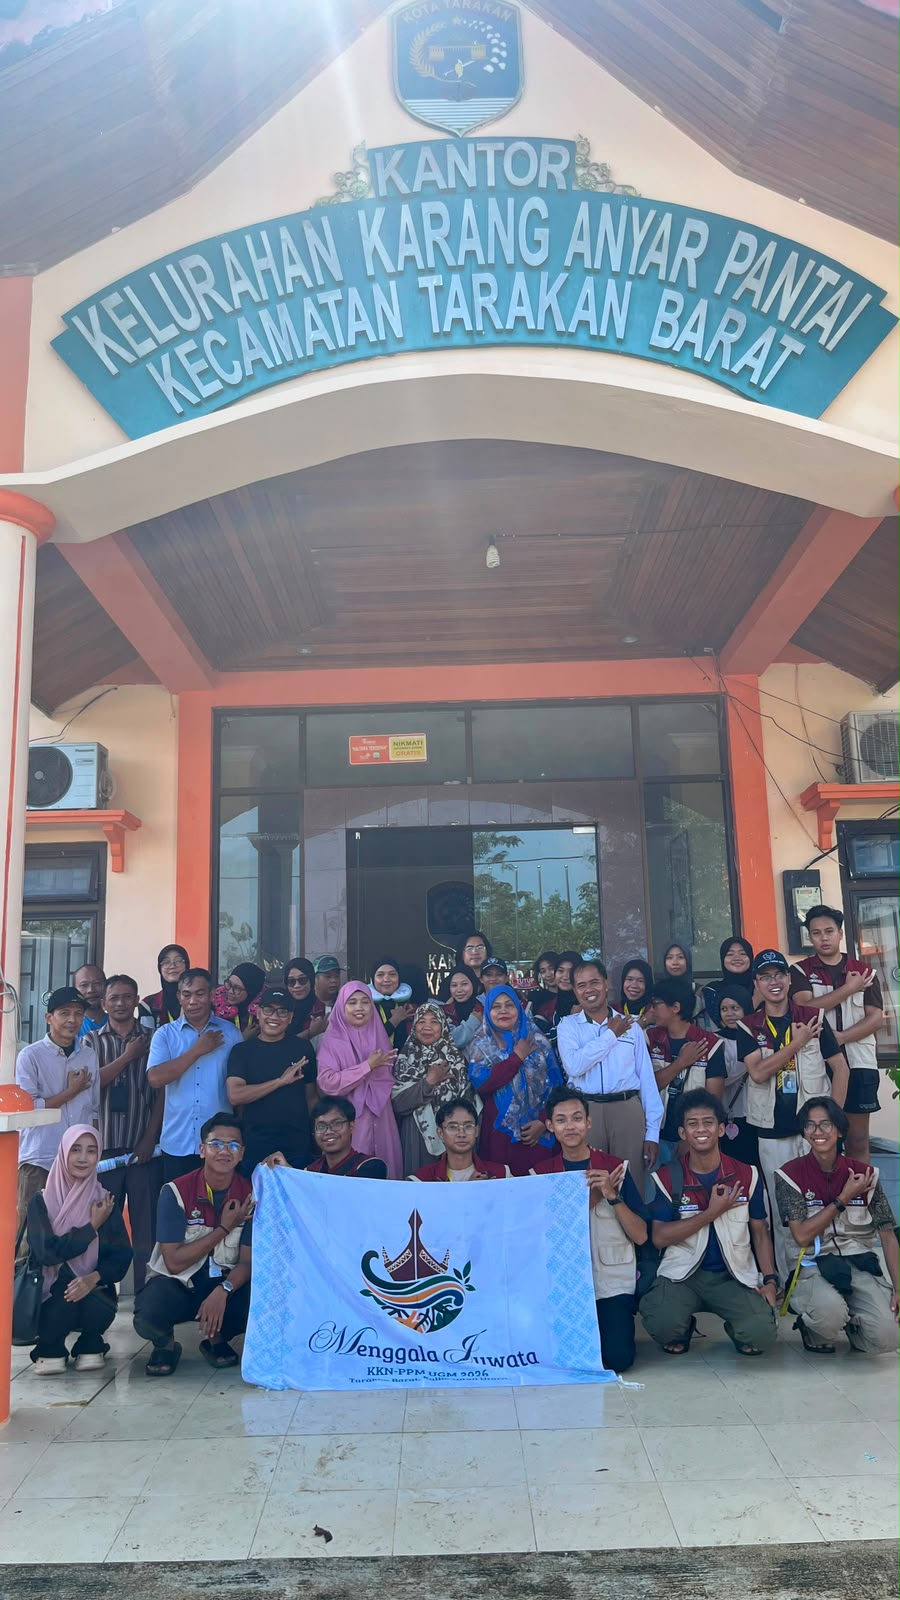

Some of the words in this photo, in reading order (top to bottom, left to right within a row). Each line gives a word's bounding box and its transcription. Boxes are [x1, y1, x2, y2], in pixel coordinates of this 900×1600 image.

[402, 3, 441, 23] KOTA
[445, 0, 513, 21] TARAKAN
[374, 141, 571, 197] KANTOR
[71, 215, 345, 377] KELURAHAN
[358, 196, 550, 277] KARANG
[563, 200, 709, 290] ANYAR
[713, 229, 873, 352] PANTAI
[146, 279, 404, 416] KECAMATAN
[417, 271, 632, 342] TARAKAN
[649, 288, 806, 391] BARAT
[308, 1320, 440, 1364] Menggala
[367, 1366, 425, 1376] KKN-PPM
